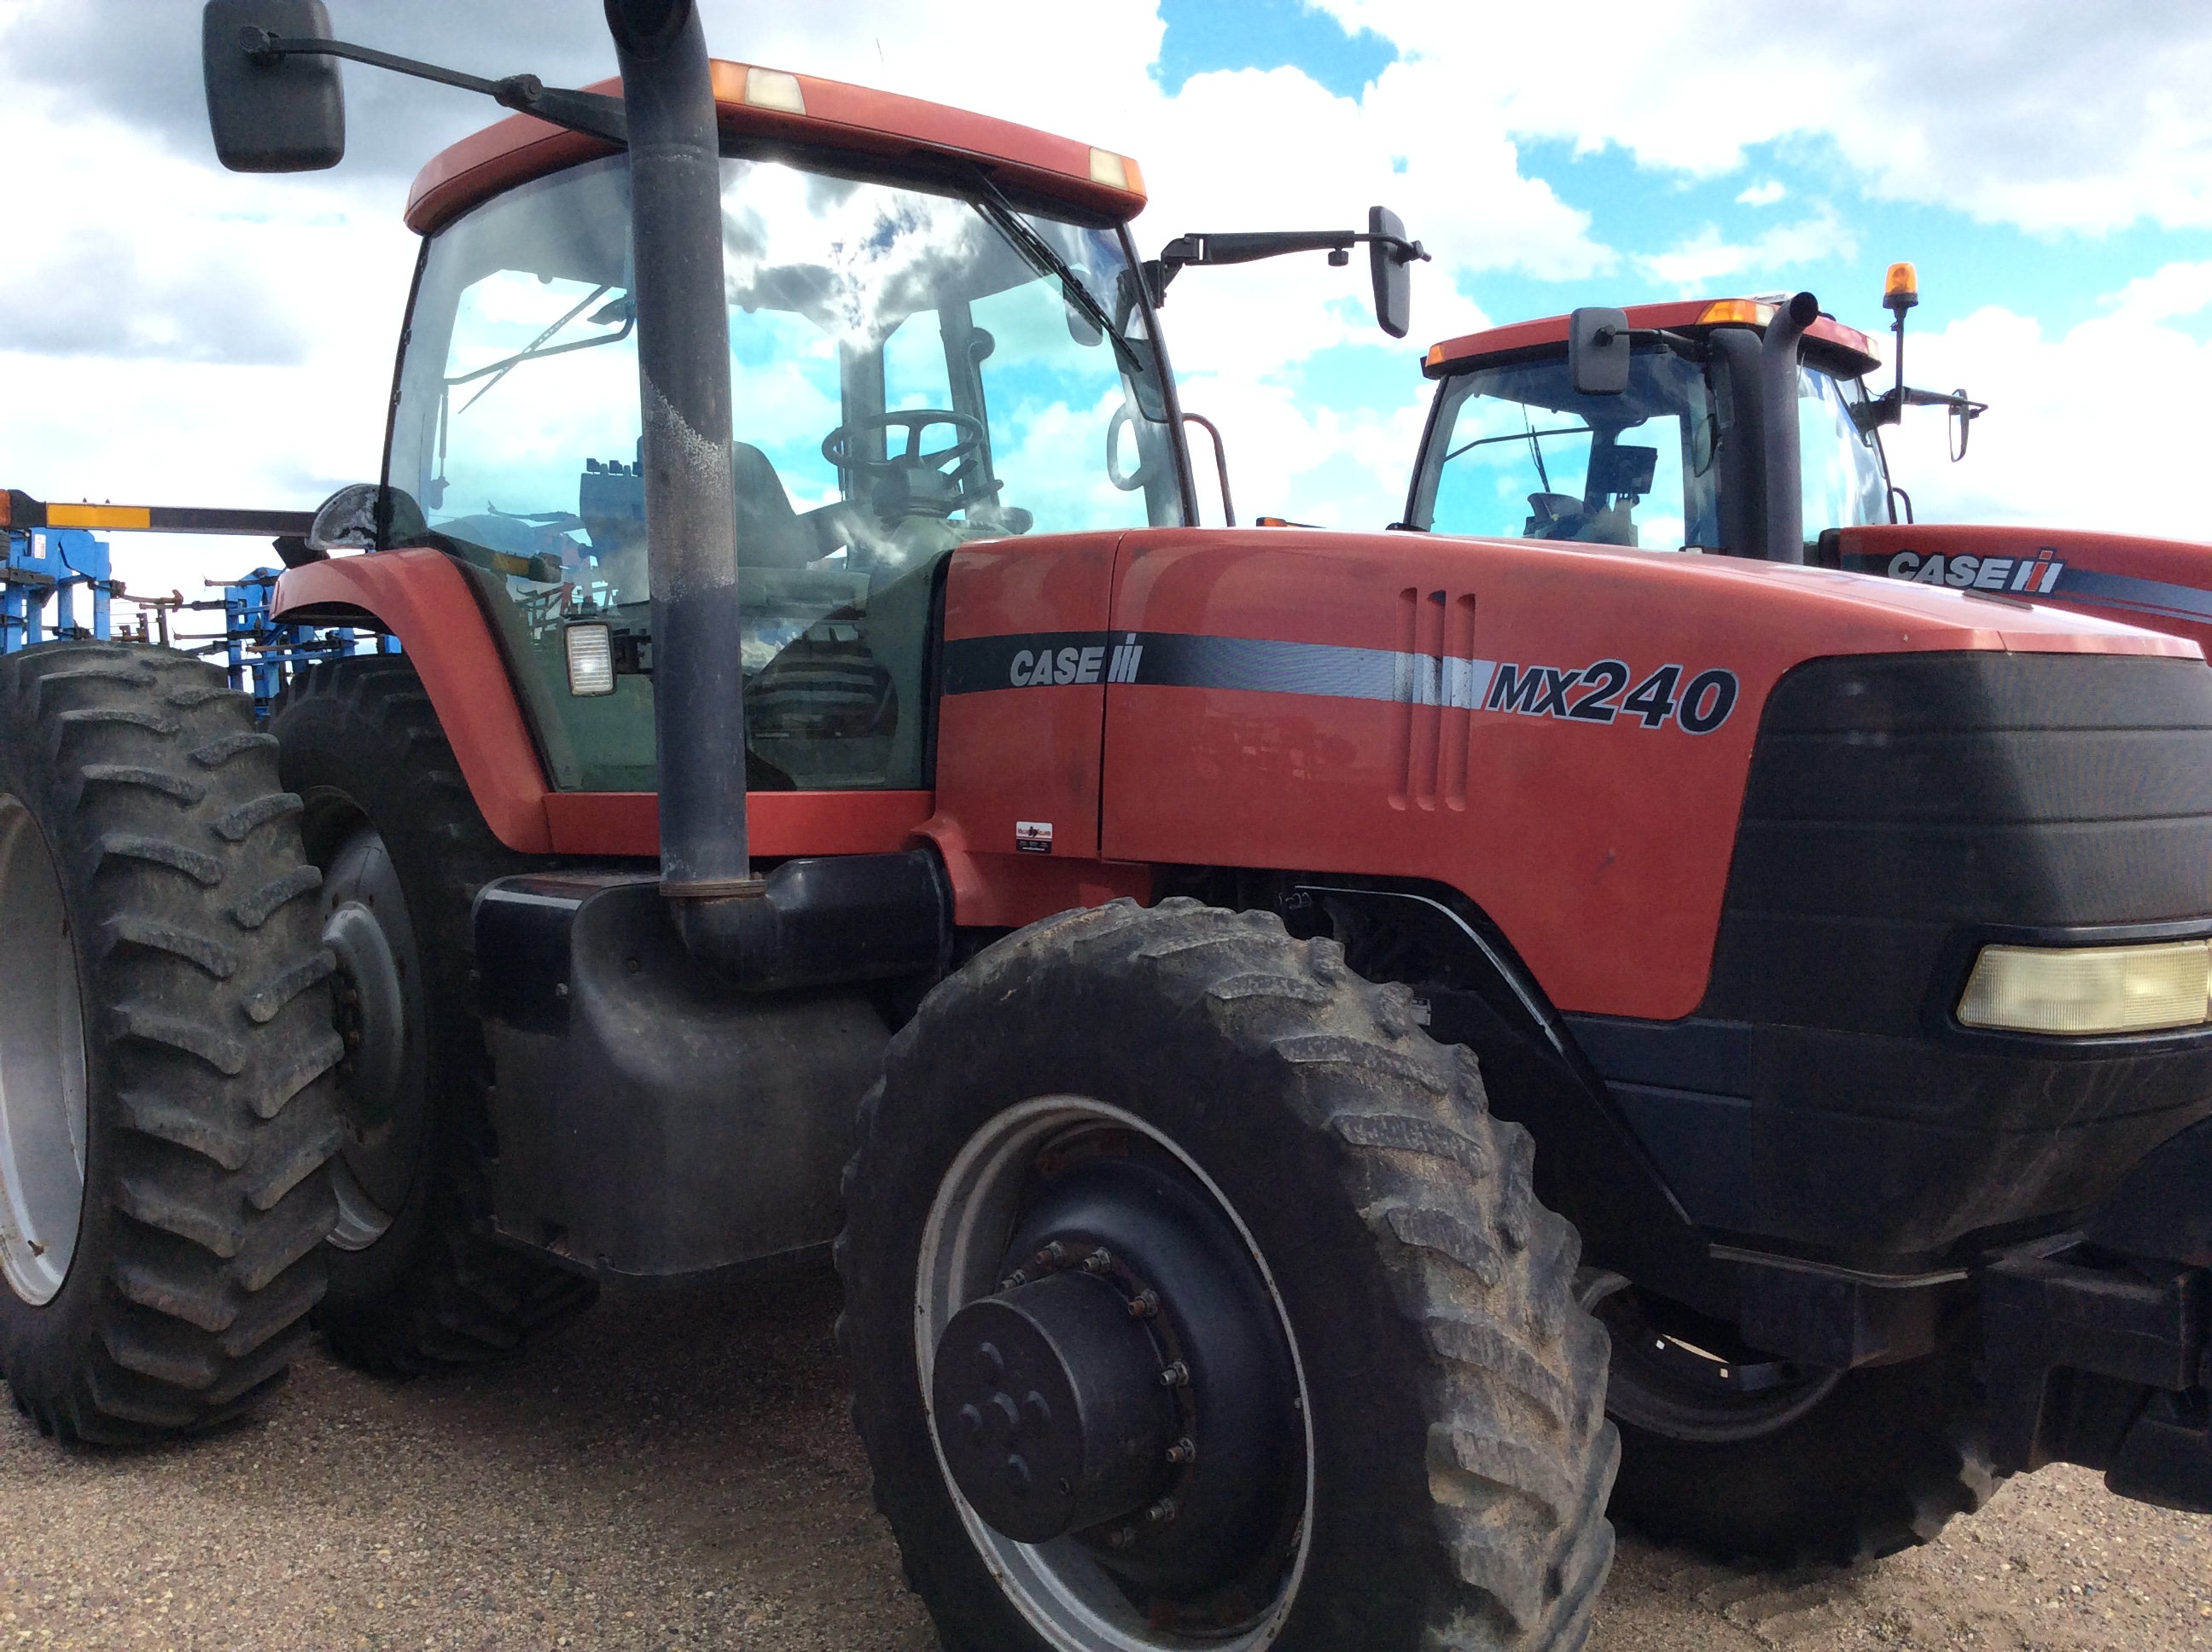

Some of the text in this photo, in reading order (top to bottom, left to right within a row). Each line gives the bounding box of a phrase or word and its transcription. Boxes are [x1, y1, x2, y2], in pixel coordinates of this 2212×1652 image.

[1888, 551, 2014, 590] CASE
[1010, 646, 1106, 687] CASE
[1485, 658, 1740, 736] MX240
